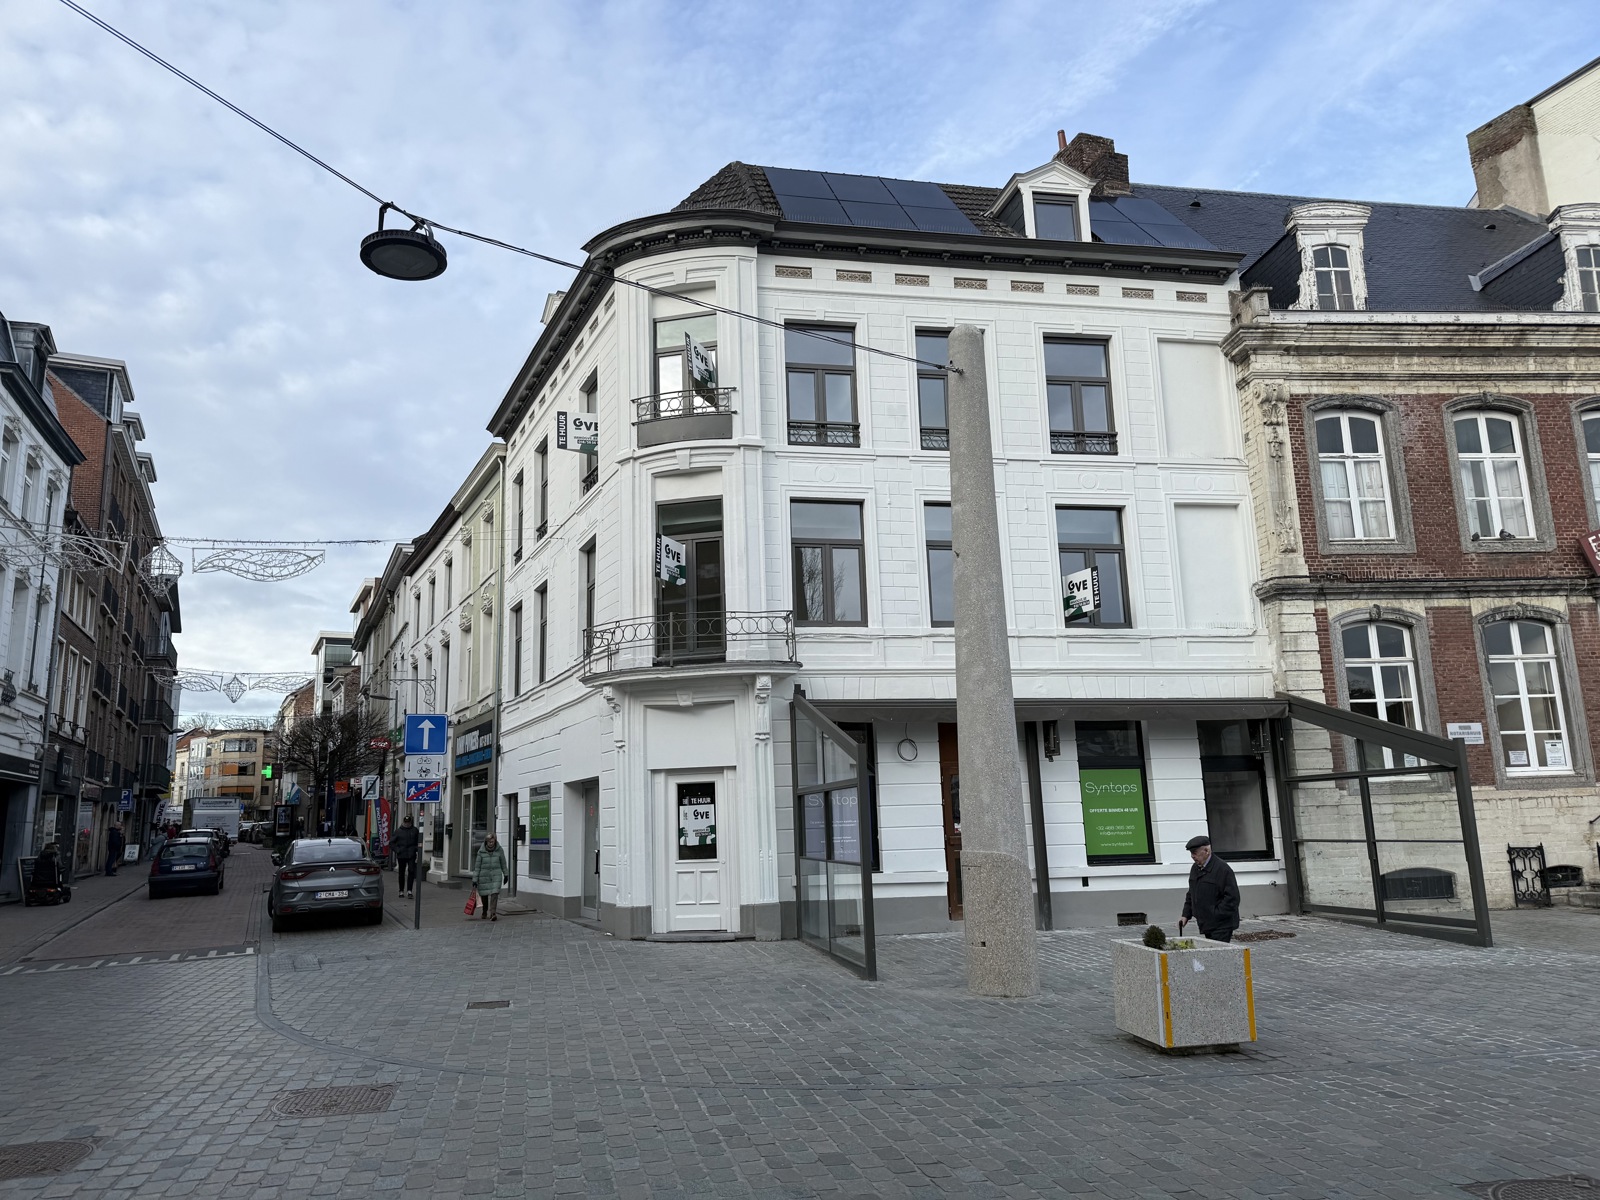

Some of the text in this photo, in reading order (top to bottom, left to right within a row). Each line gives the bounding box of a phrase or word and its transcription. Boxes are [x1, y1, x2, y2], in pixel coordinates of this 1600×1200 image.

[558, 436, 566, 446] TE
[656, 563, 661, 573] TE
[1094, 594, 1100, 605] TE
[1085, 782, 1138, 795] Syntops
[121, 790, 128, 799] P
